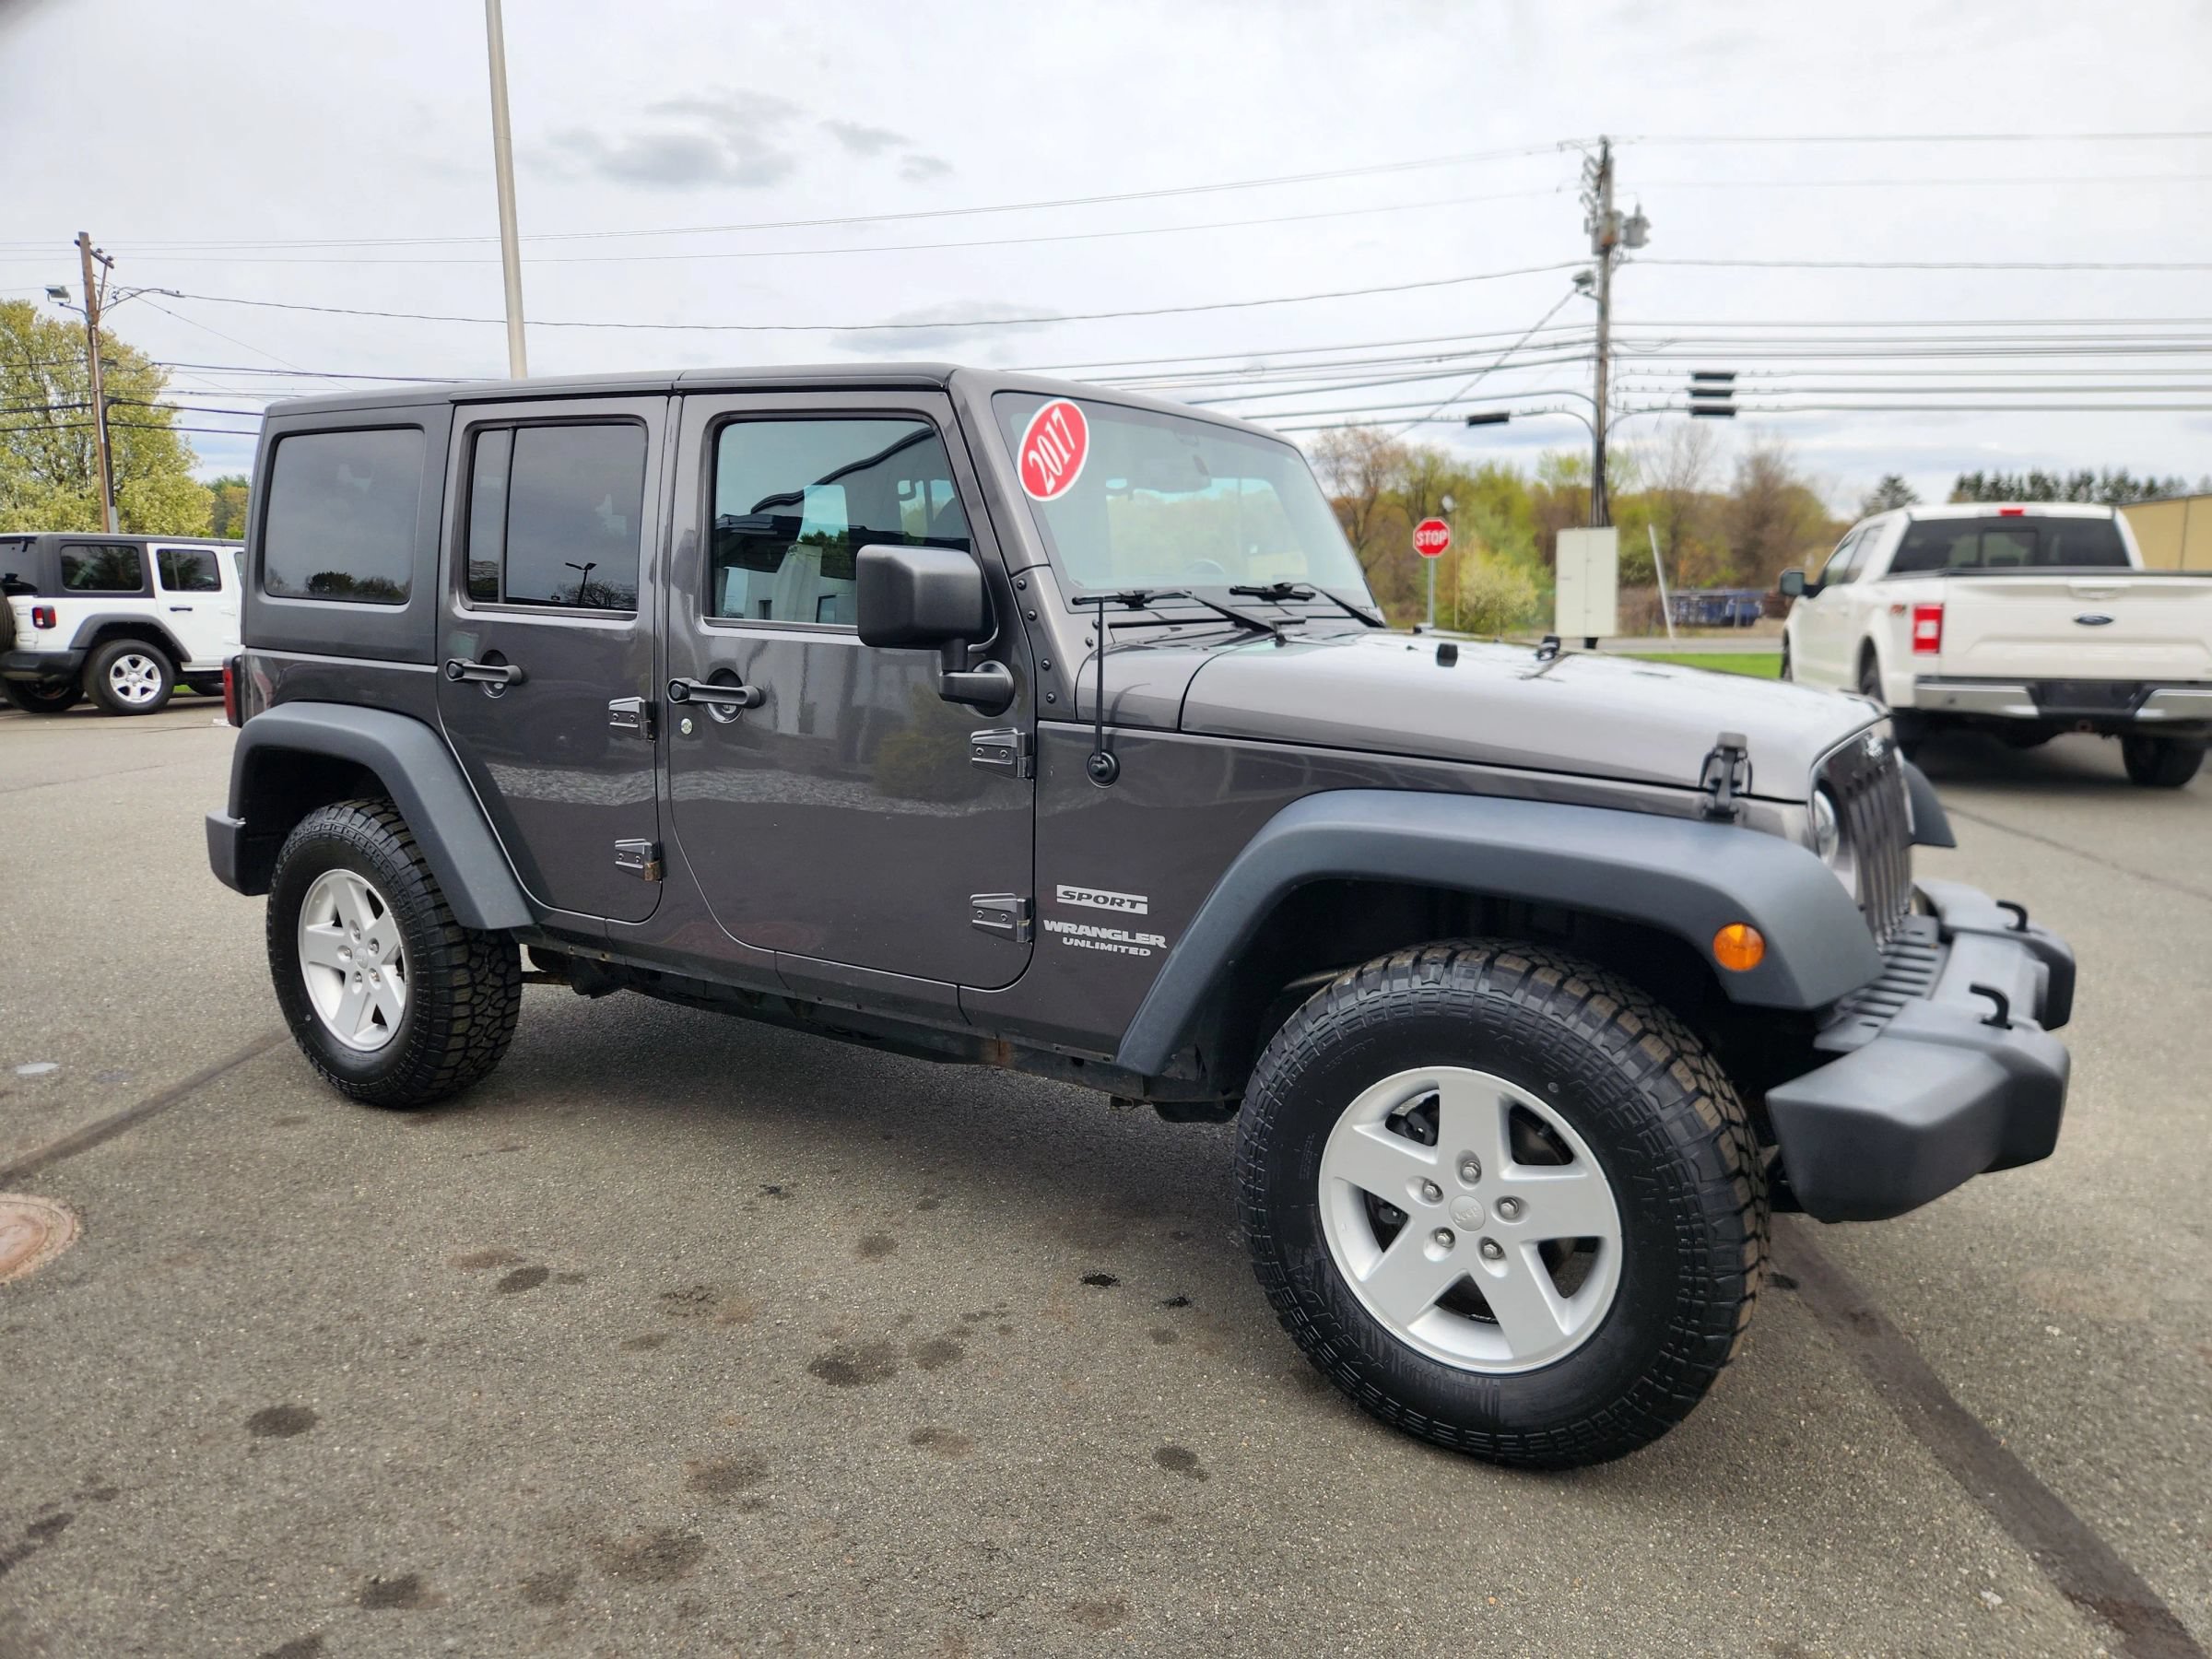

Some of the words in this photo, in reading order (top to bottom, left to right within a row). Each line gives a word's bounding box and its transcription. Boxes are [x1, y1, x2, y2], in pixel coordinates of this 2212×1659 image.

[1028, 406, 1076, 494] 2017
[1416, 530, 1448, 546] STOP
[1058, 888, 1147, 911] SPORT
[1043, 920, 1167, 948] WRANGLER
[1063, 937, 1151, 956] UNLIMITED
[1453, 1206, 1479, 1223] Jeep
